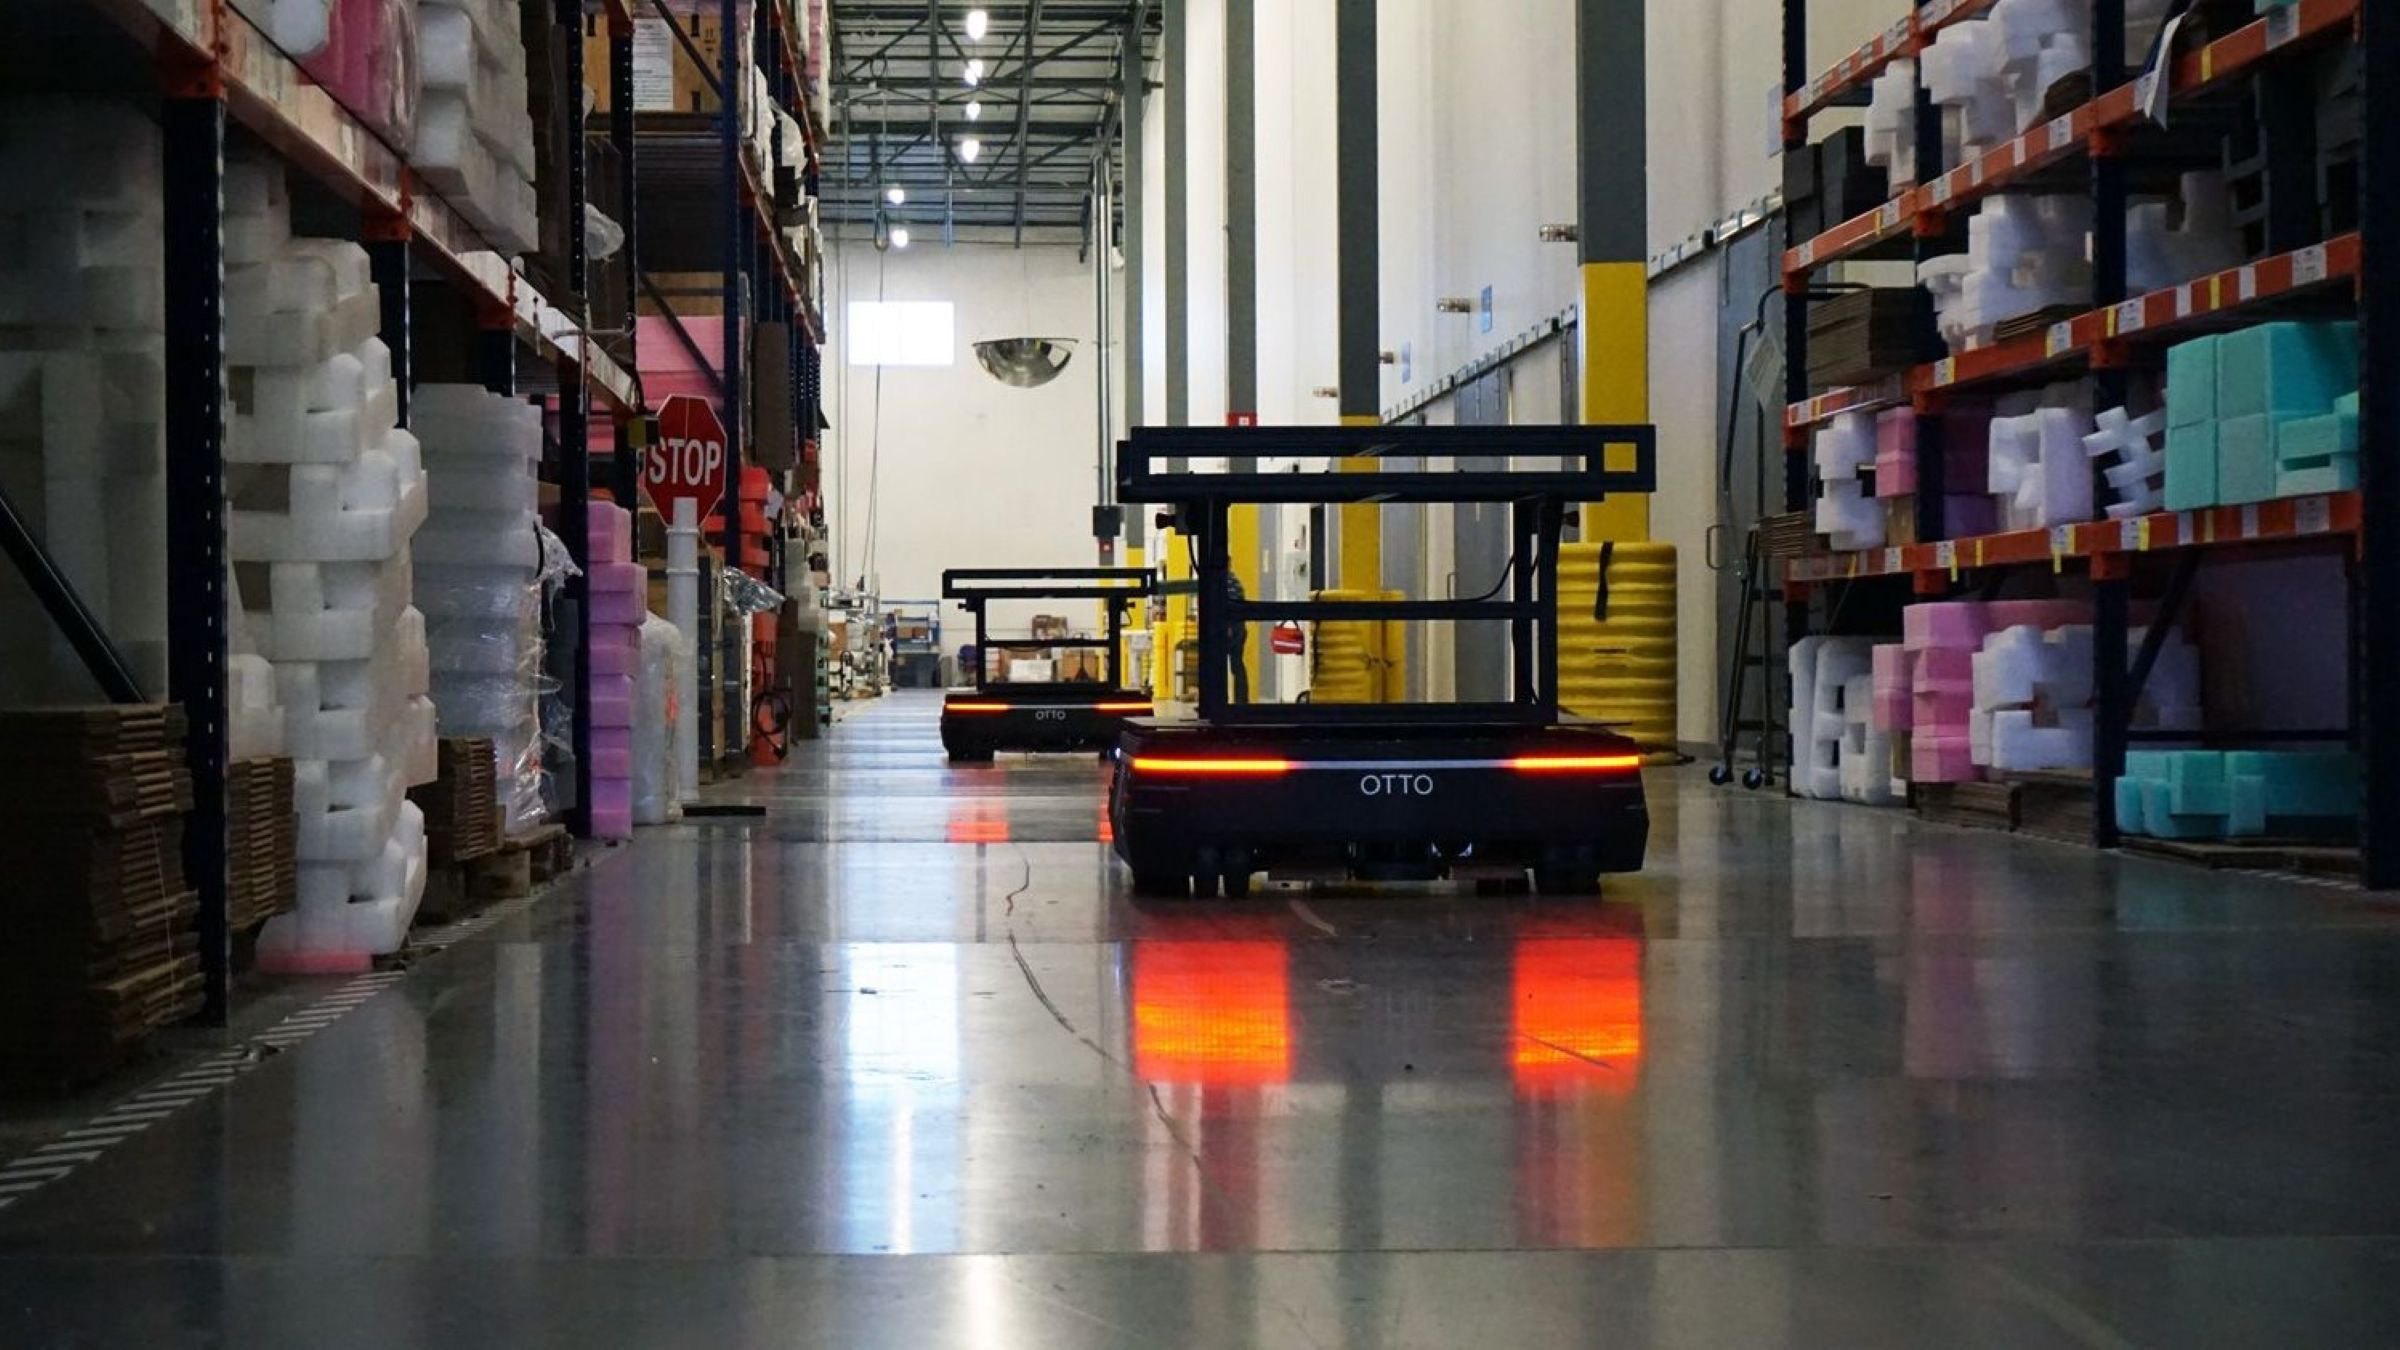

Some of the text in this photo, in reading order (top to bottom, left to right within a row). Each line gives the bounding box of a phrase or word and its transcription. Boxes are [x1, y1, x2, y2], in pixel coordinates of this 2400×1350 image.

[649, 437, 721, 486] STOP
[1035, 710, 1066, 720] OTTO
[1360, 774, 1434, 796] OTTO
